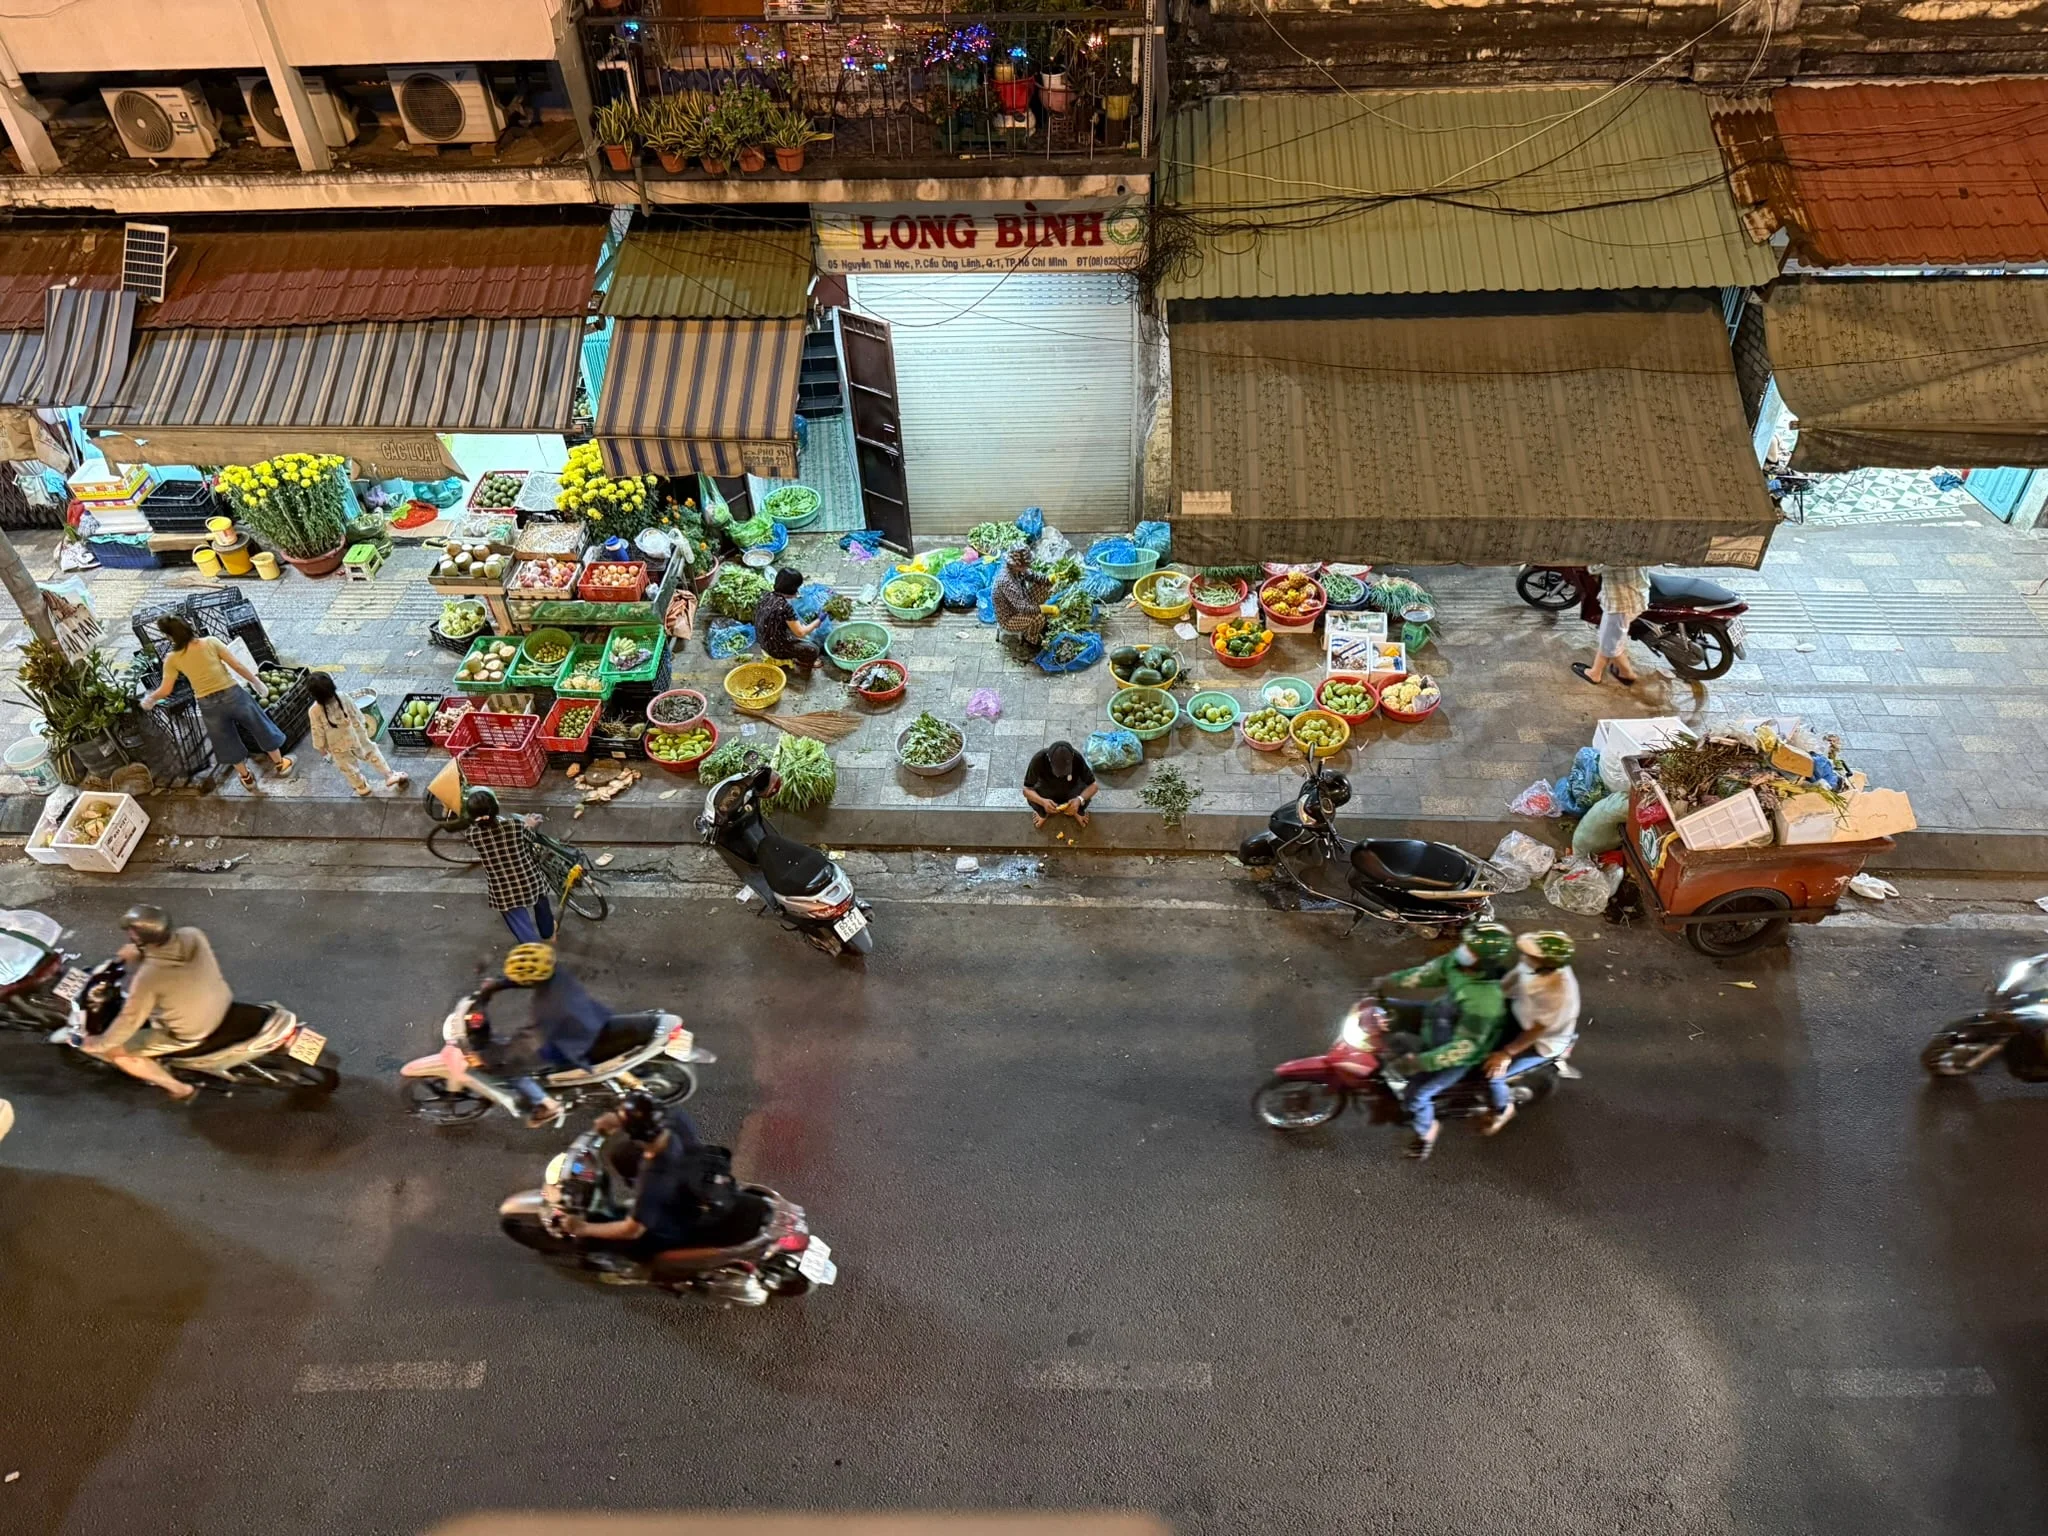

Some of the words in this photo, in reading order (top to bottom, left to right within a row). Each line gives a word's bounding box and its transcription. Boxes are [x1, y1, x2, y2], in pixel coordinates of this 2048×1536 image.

[859, 213, 977, 250] LONG
[994, 201, 1104, 248] BÌNH
[828, 260, 838, 269] 05
[874, 259, 891, 269] Thái
